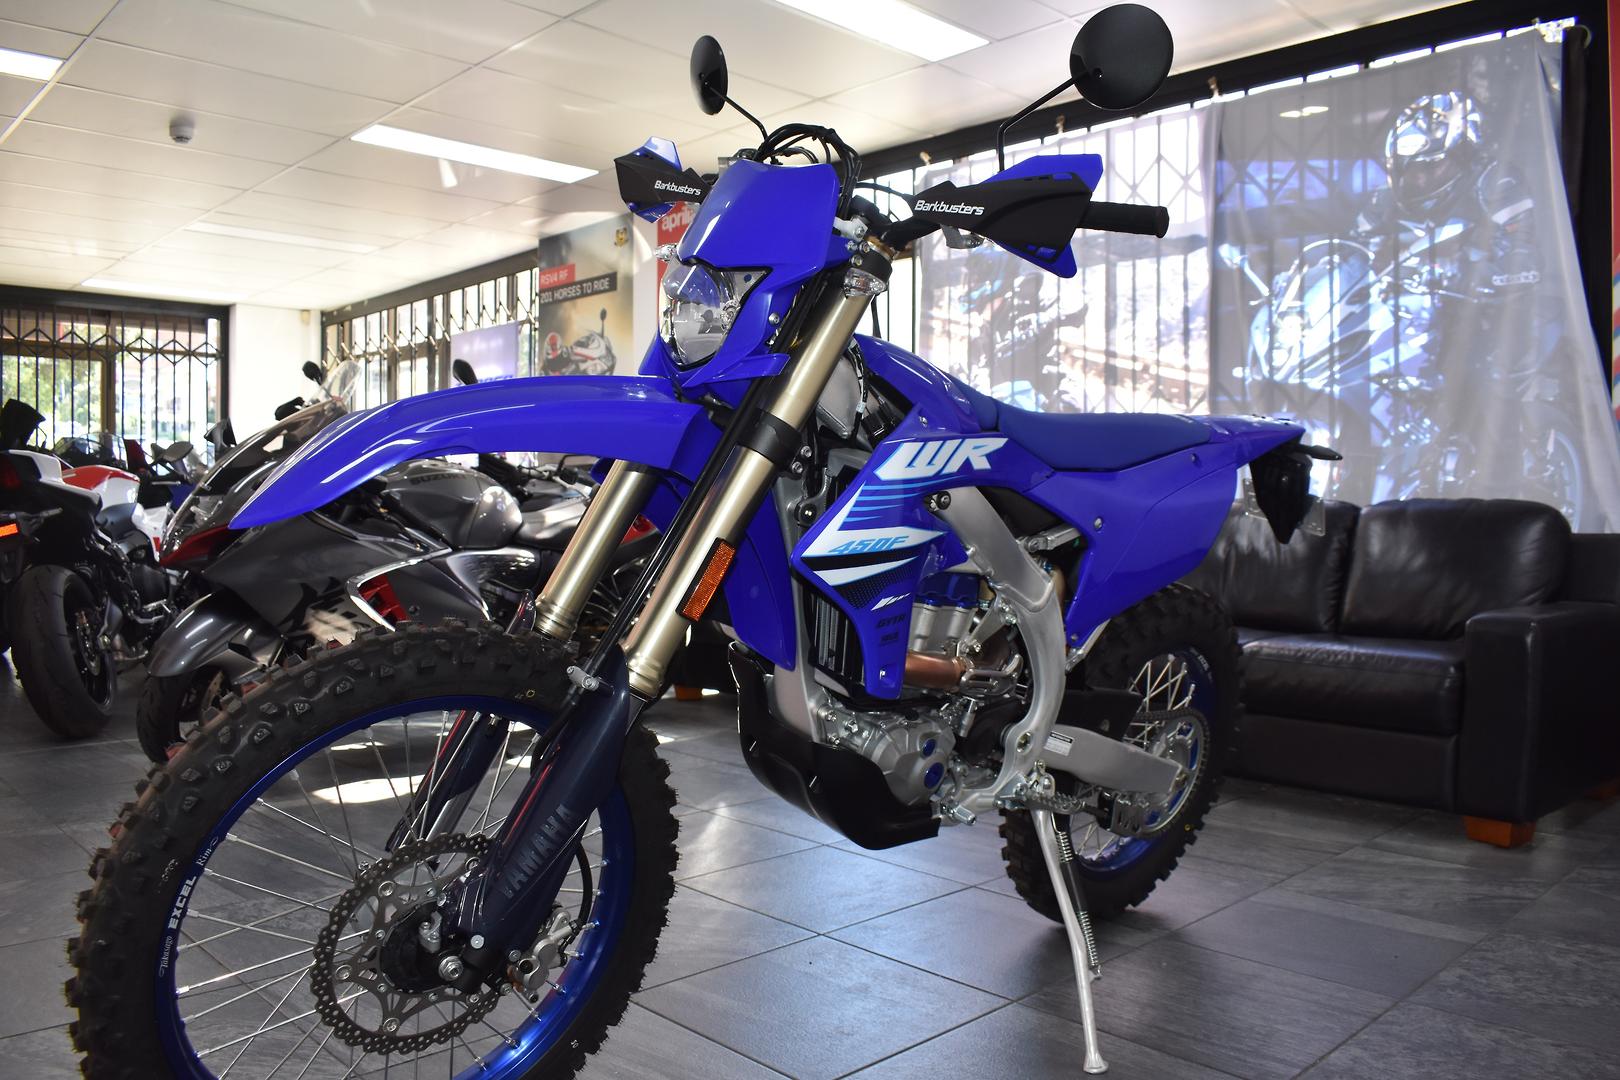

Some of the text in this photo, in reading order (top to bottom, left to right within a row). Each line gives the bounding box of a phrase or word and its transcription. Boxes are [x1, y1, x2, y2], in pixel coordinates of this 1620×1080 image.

[654, 180, 702, 196] Barkbusters
[914, 199, 985, 216] Barkbusters
[540, 277, 610, 304] 201 HORSES TO RIDE
[873, 438, 1009, 480] WR
[827, 535, 910, 554] 450F
[168, 876, 197, 929] EXCEL
